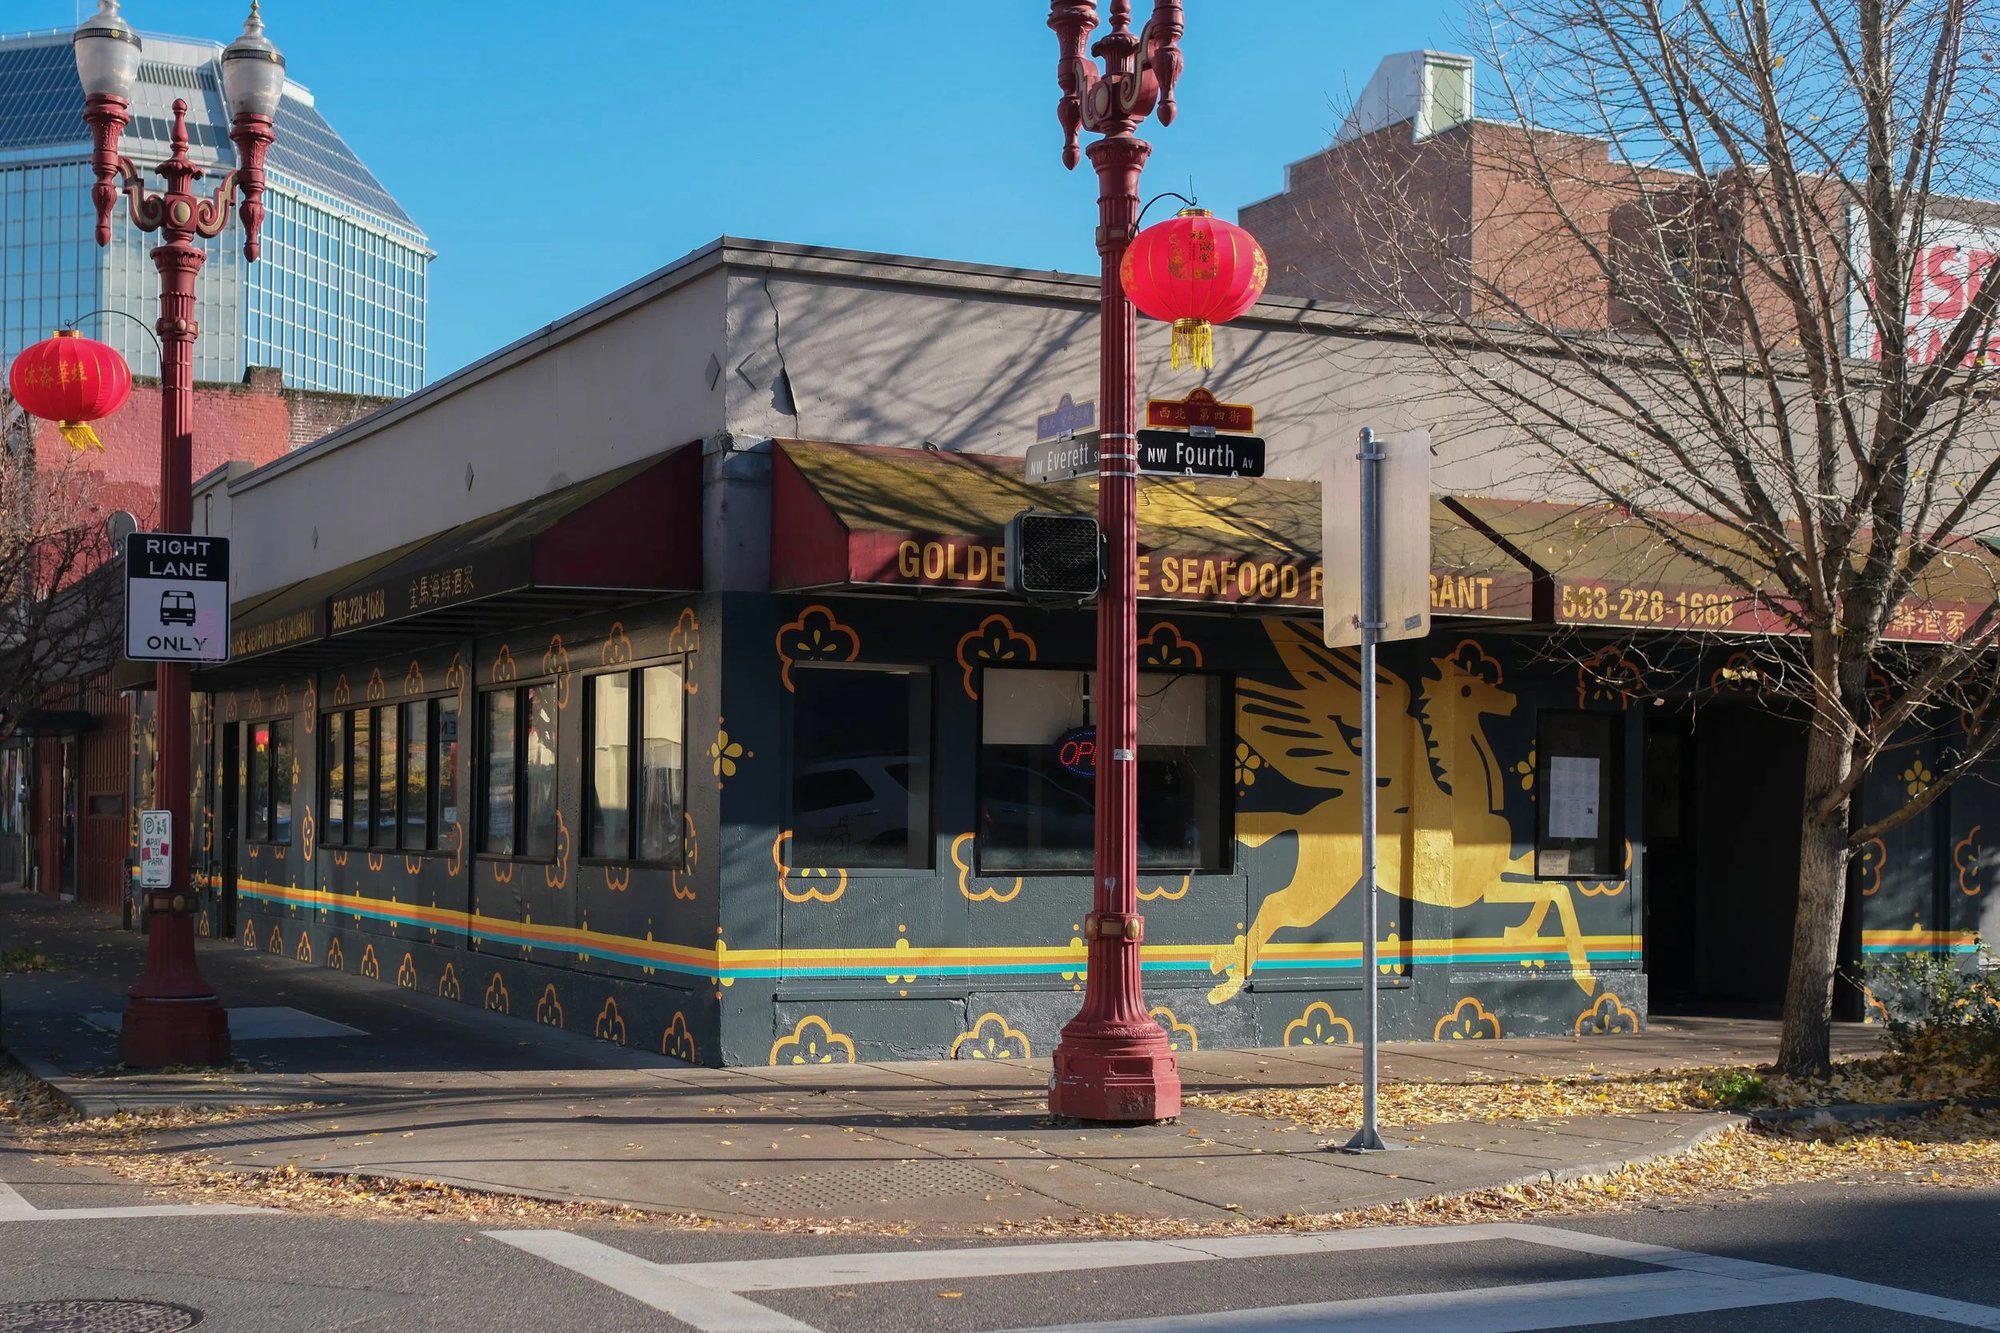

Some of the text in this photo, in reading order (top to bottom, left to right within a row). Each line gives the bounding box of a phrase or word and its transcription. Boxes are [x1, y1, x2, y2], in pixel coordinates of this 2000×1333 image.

[1160, 406, 1186, 420] 西北
[1030, 460, 1043, 475] NW
[1047, 442, 1089, 472] Everett
[1147, 447, 1167, 463] NW
[1176, 442, 1235, 467] Fourth
[146, 539, 211, 555] RIGHT
[149, 560, 208, 577] LANE
[899, 540, 1005, 581] GOLDE
[1161, 556, 1300, 599] SEAFOOD
[333, 588, 385, 630] 503-228-1688
[146, 635, 208, 651] ONLY
